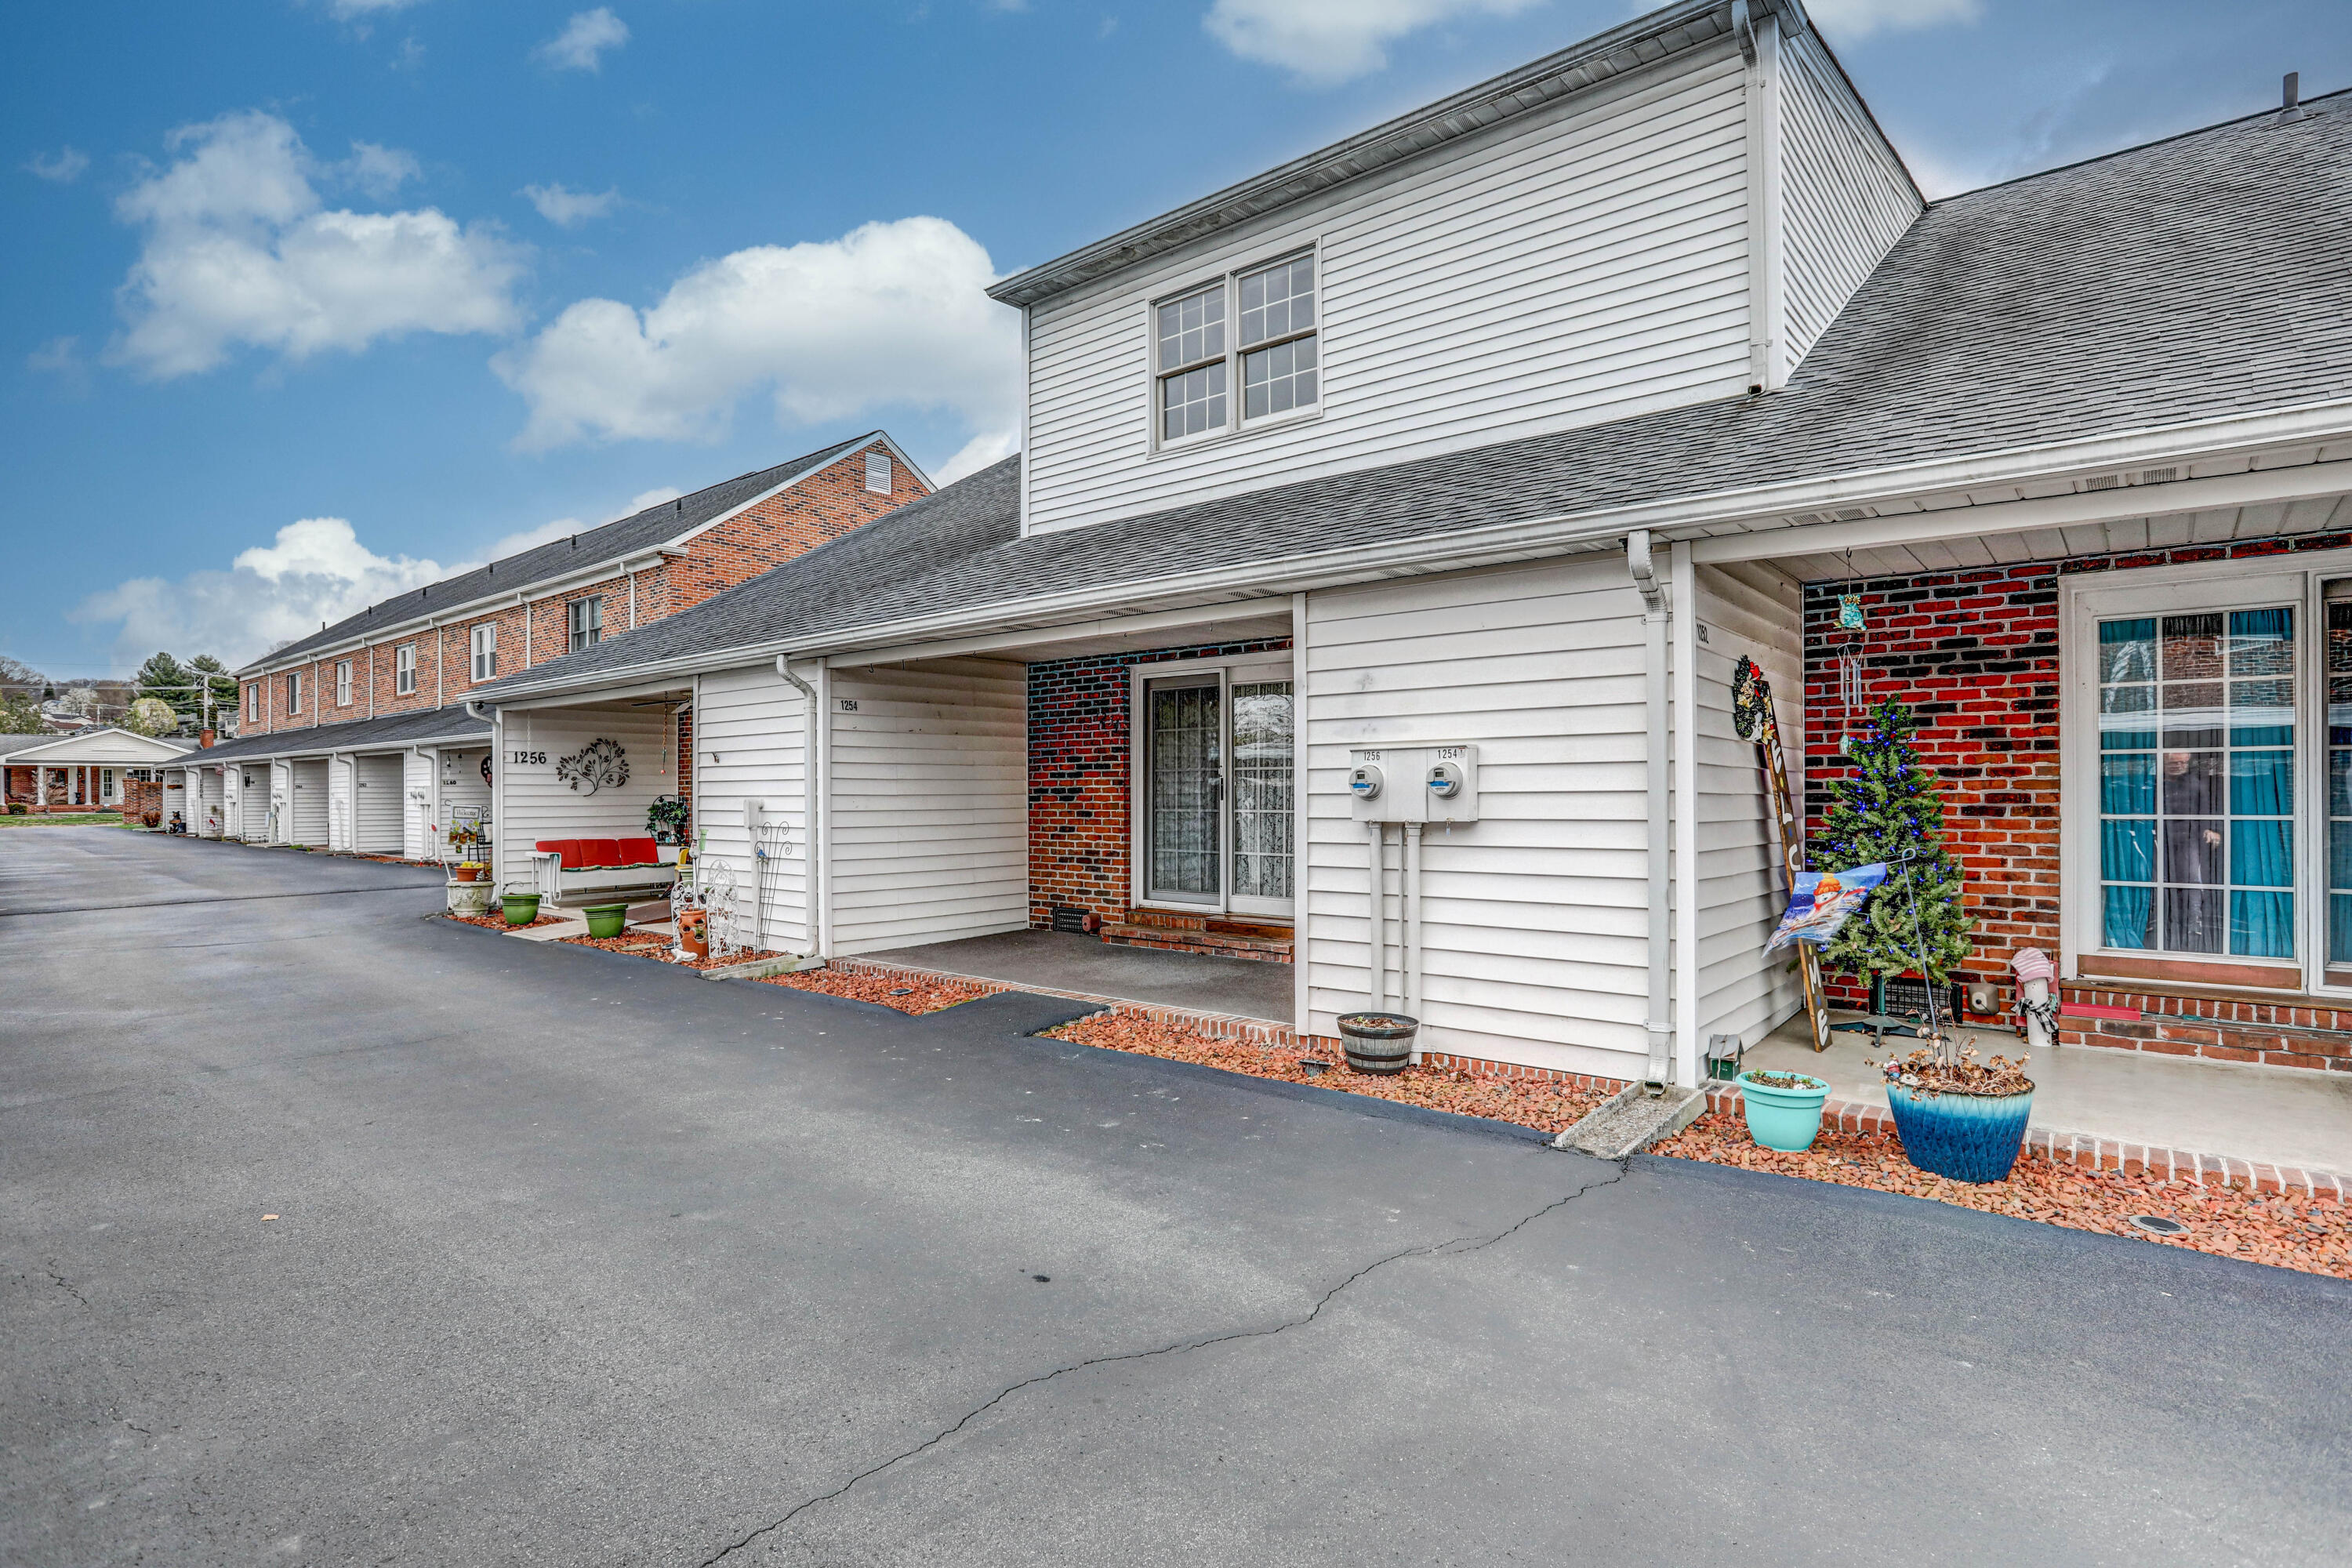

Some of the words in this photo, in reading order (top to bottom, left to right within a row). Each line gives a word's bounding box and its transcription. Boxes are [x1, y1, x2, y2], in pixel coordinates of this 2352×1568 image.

[1697, 623, 1709, 644] 1252
[840, 700, 858, 711] 1254
[514, 751, 546, 764] 1256
[1364, 751, 1381, 760] 1256
[1438, 749, 1457, 759] 1254
[1767, 688, 1829, 1046] ELCME
